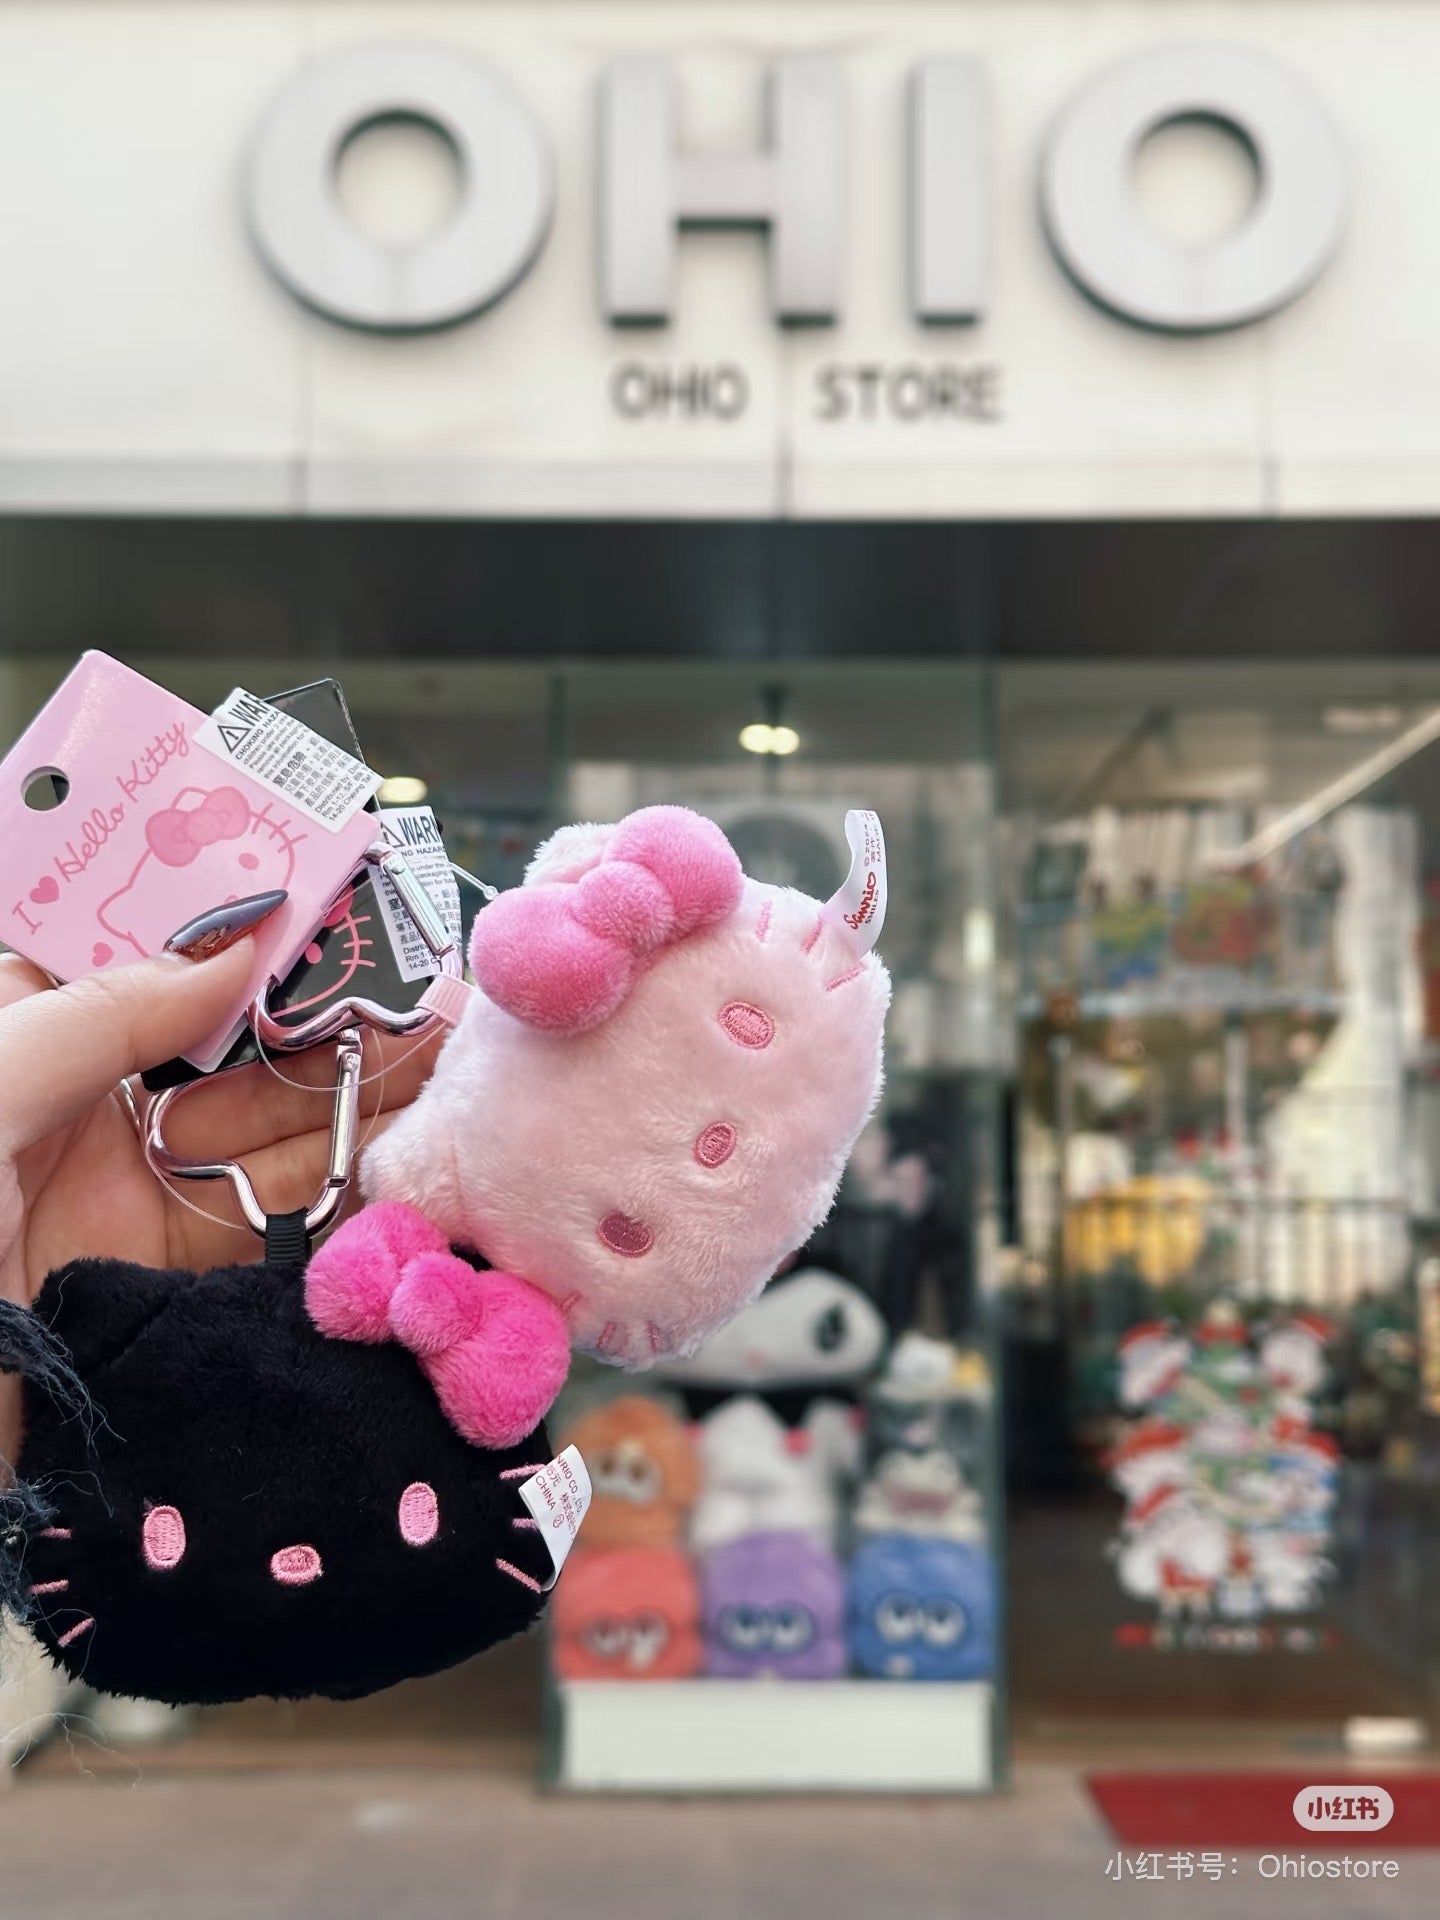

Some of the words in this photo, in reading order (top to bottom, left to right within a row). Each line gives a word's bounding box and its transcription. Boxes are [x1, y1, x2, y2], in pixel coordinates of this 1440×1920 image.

[243, 38, 1347, 338] OHIO
[609, 360, 750, 422] OHIO
[814, 361, 1004, 423] STORE
[235, 728, 264, 760] CHOKING
[314, 782, 344, 814] Distributed
[329, 804, 346, 822] 14-20
[12, 900, 43, 935] I
[54, 802, 124, 882] Hello
[116, 722, 189, 802] Kitty
[843, 871, 877, 930] Sanrio
[408, 959, 429, 970] 14-20
[536, 1475, 556, 1510] CHINA
